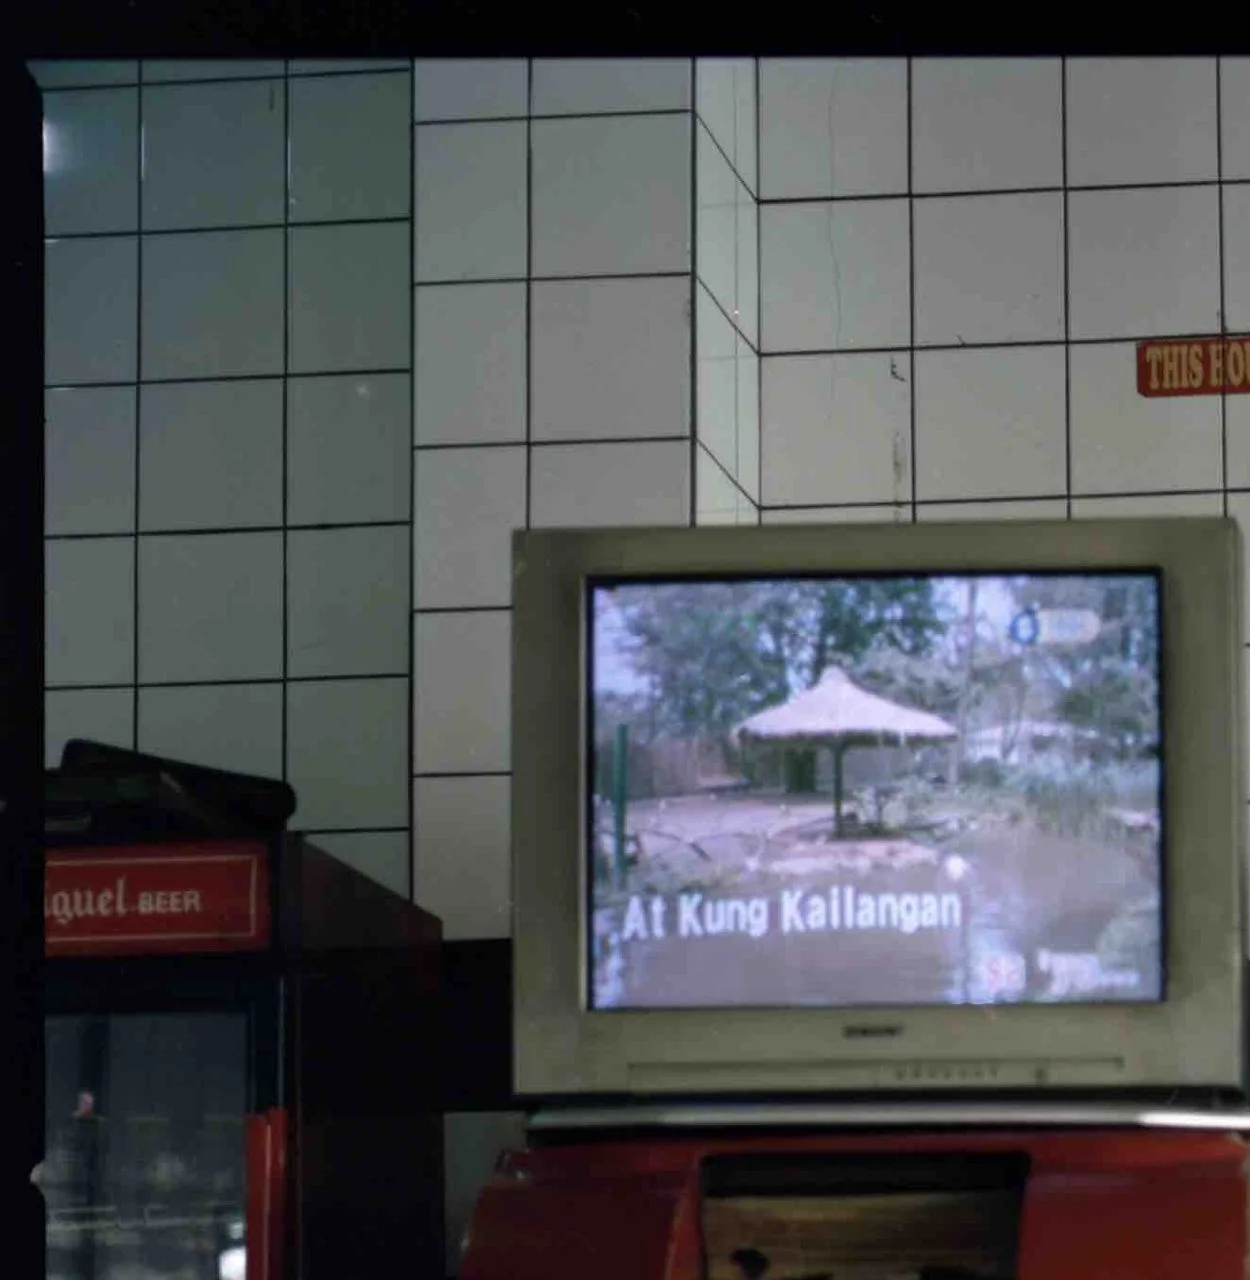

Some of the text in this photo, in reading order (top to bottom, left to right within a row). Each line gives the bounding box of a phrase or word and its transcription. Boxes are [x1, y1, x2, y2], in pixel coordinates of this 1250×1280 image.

[1146, 344, 1204, 390] THIS
[137, 890, 203, 915] BEER
[623, 884, 962, 941] At Kung Kailangan
